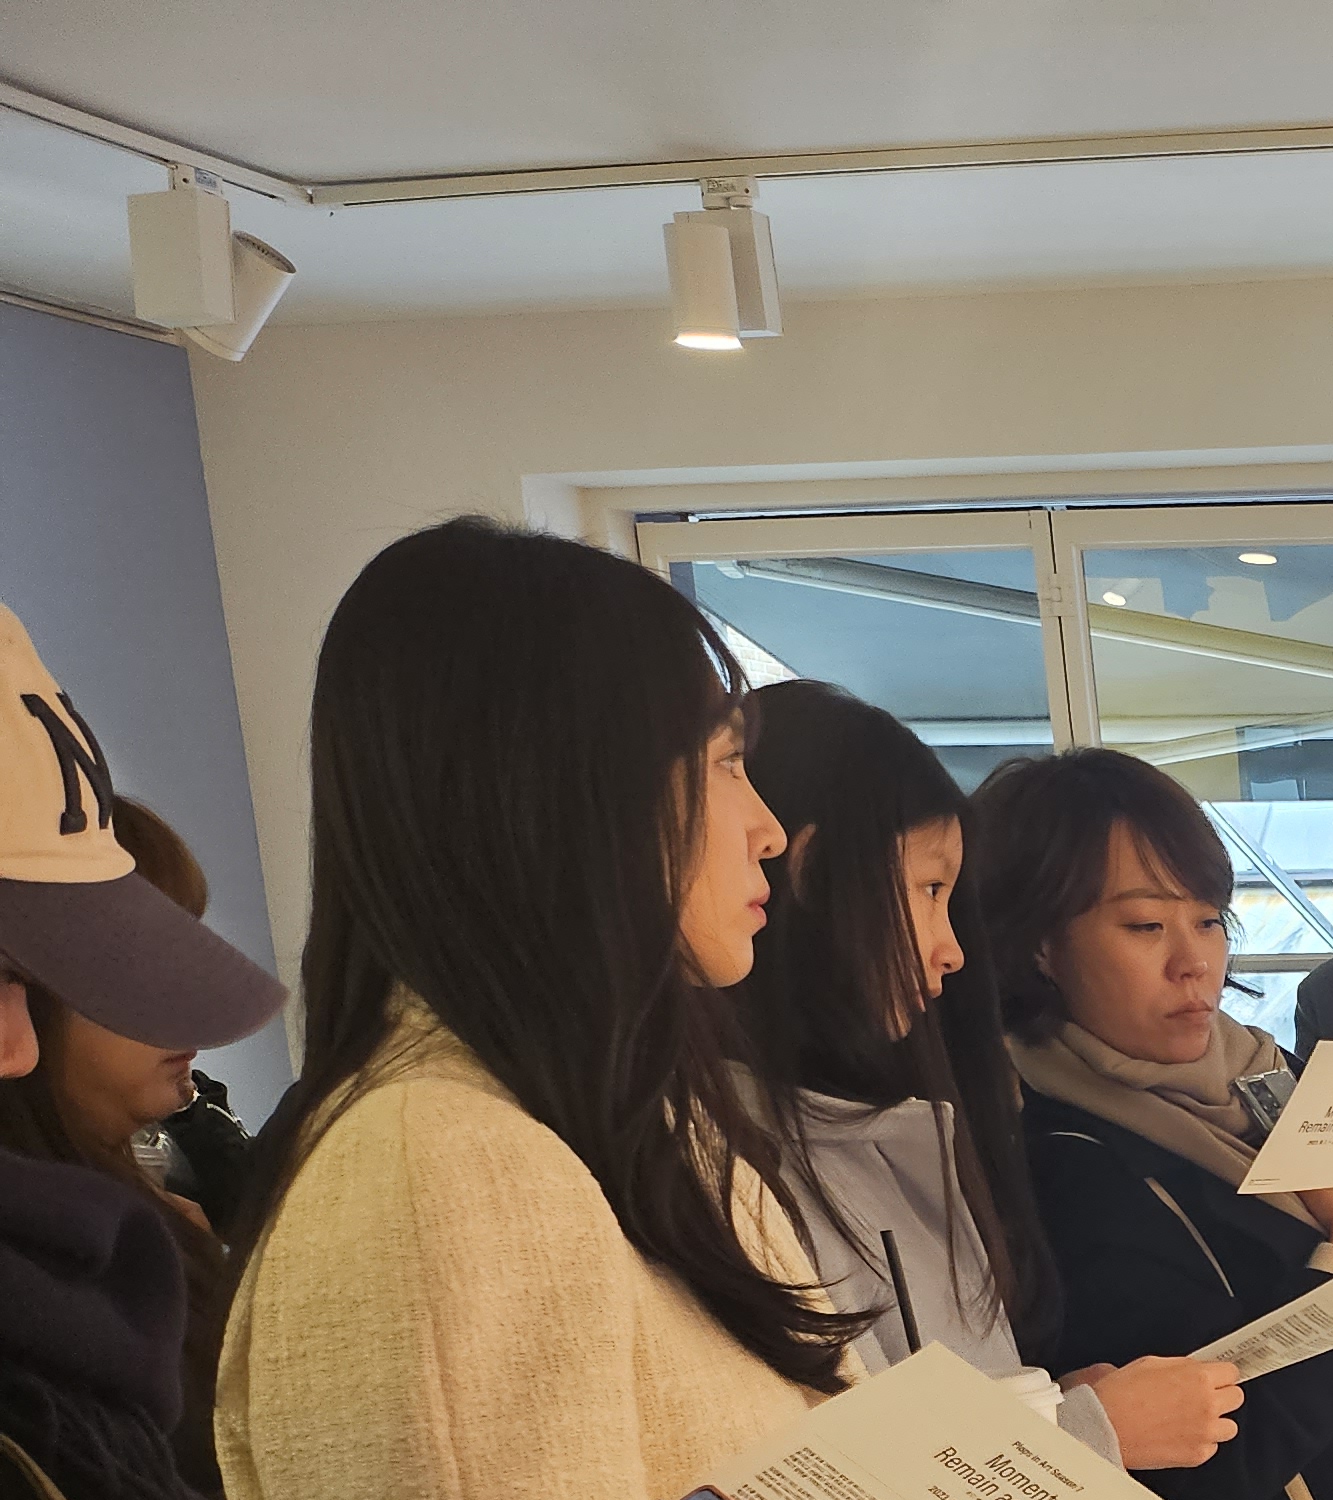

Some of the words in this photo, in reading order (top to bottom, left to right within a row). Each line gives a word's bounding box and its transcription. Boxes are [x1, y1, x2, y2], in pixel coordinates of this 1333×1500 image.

[934, 1446, 999, 1497] Remain
[1038, 1461, 1052, 1472] Art
[1050, 1468, 1078, 1490] Season
